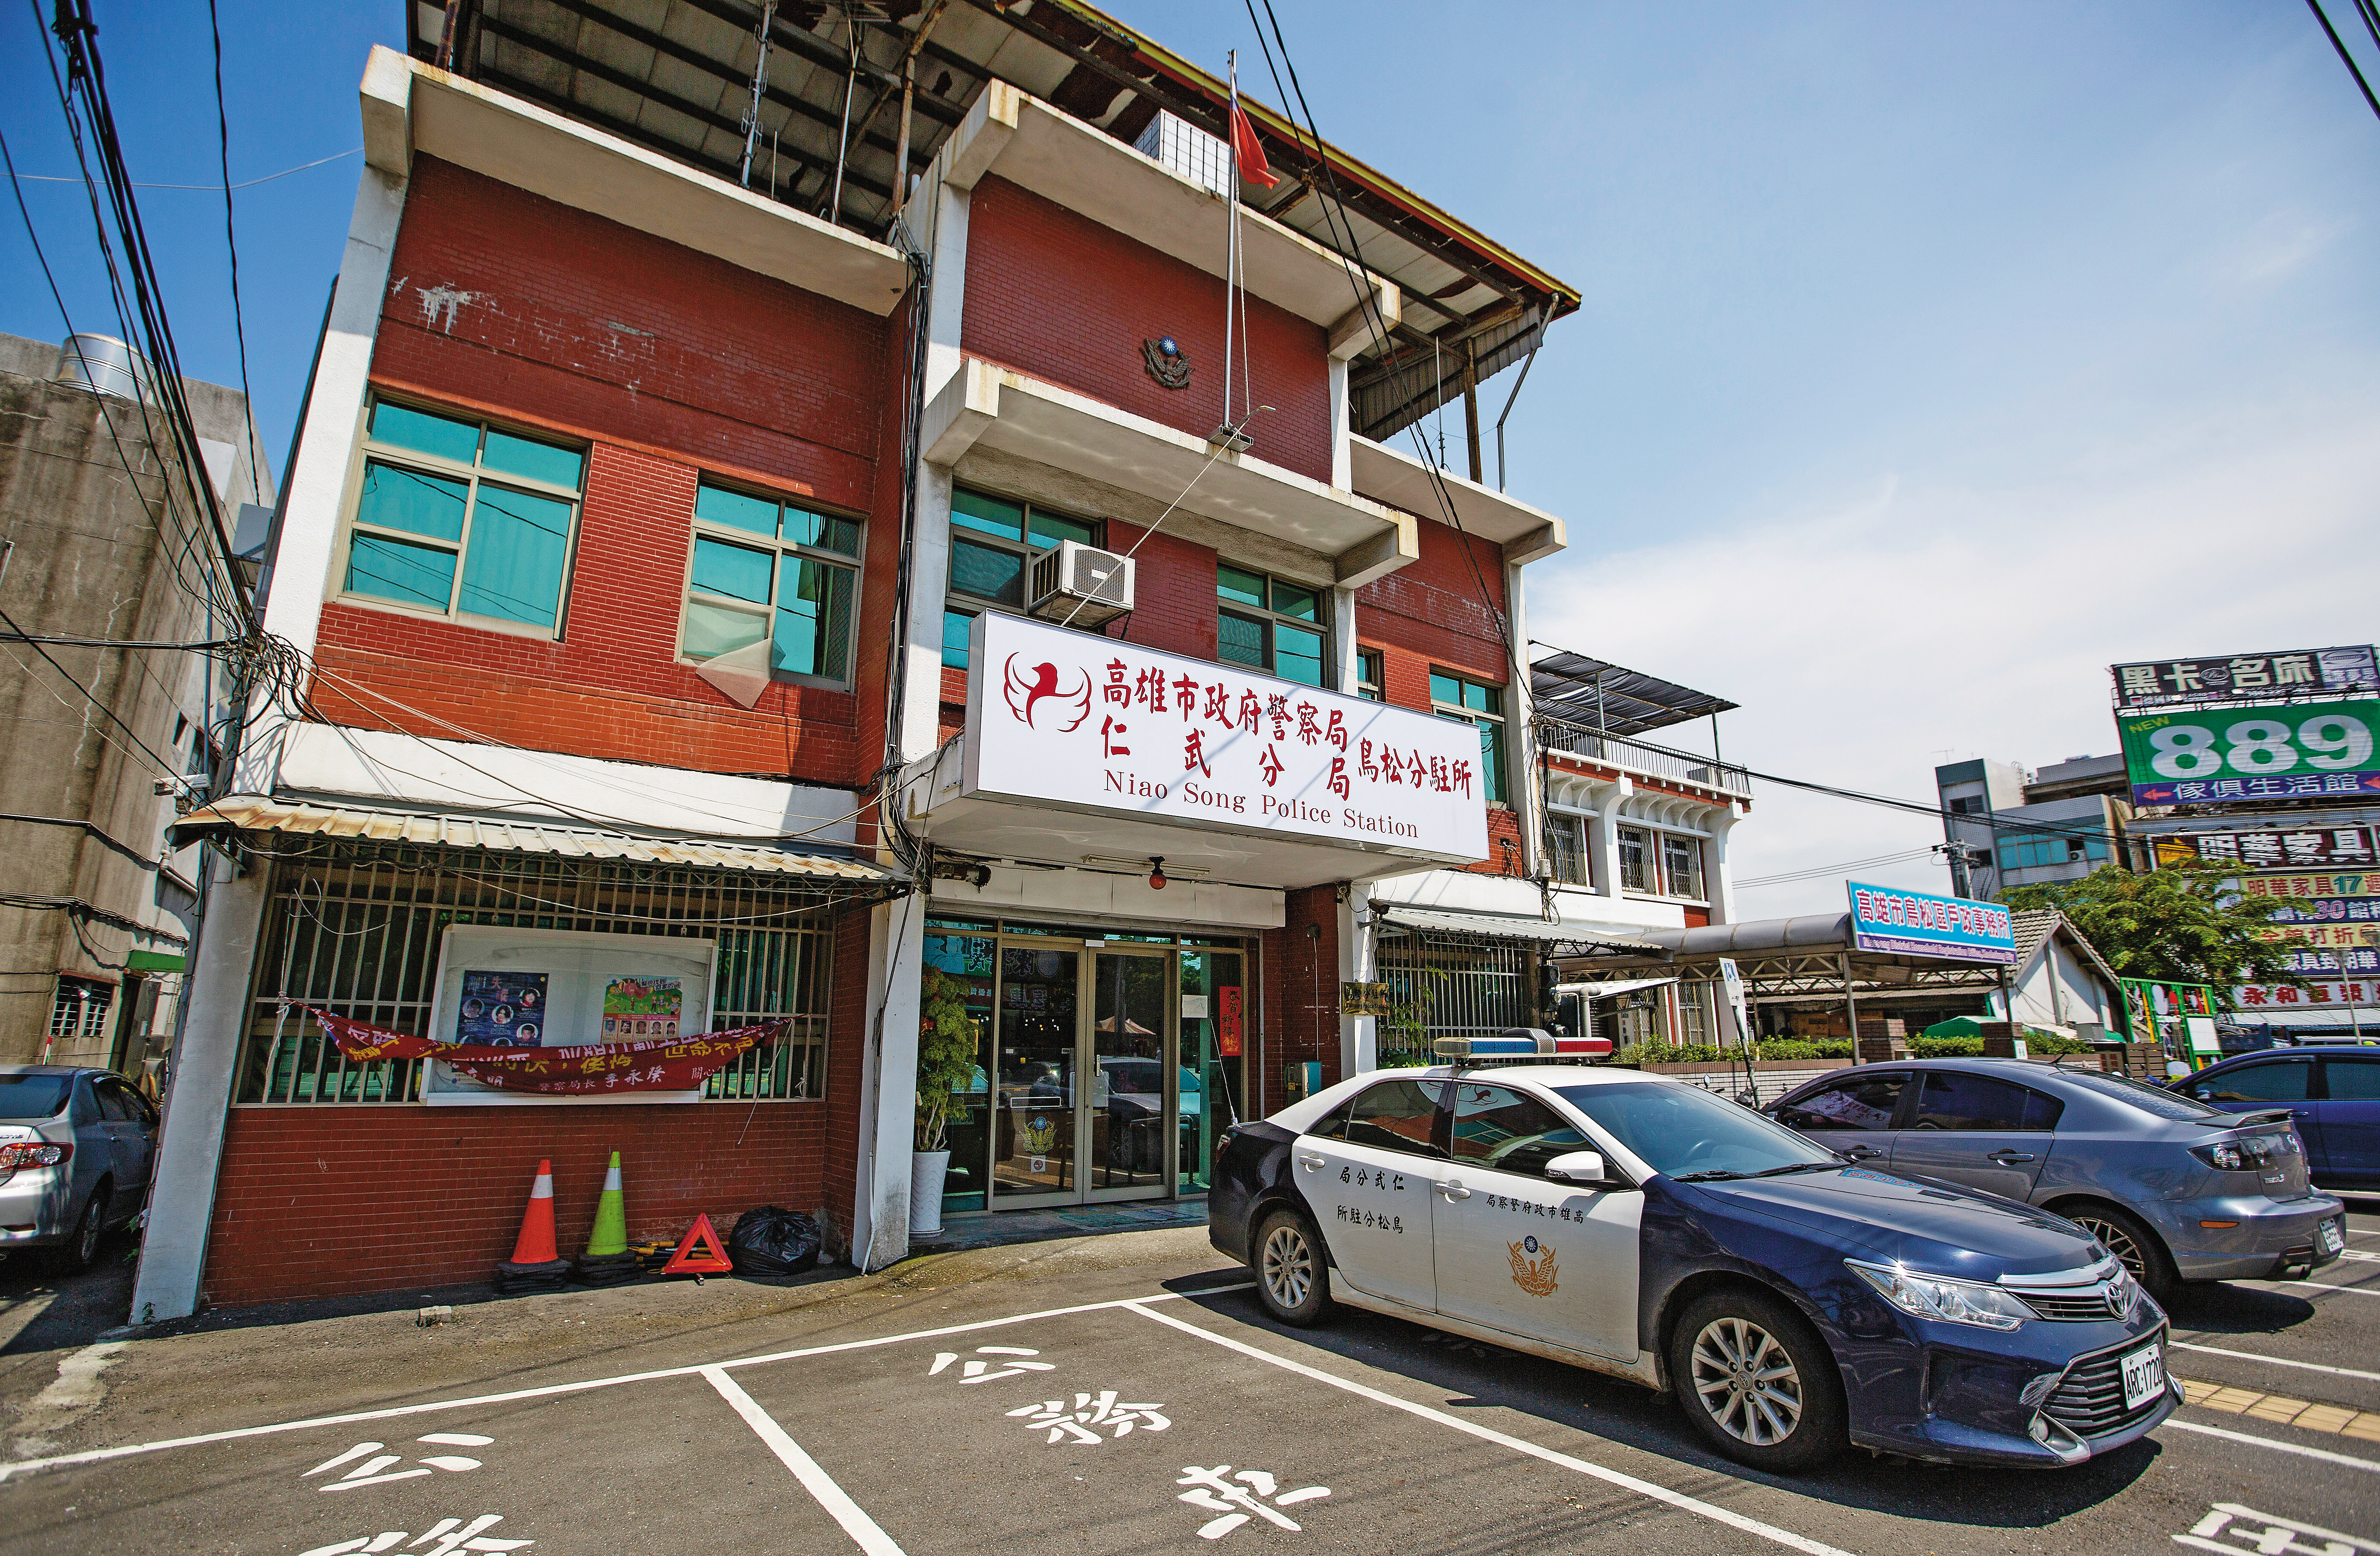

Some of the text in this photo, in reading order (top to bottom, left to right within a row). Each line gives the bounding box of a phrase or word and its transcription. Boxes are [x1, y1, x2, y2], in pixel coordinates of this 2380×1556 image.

[1104, 657, 1347, 753] 高雄市政府警察局
[2129, 715, 2170, 733] NEW
[1358, 737, 1472, 800] 鳥松分駐所
[2149, 715, 2374, 778] 889
[1104, 769, 1419, 838] Niao Song Police Station
[2172, 773, 2361, 800] 傢俱生活館
[1855, 889, 2011, 939] 高雄市鳥松區戶政事務所
[1890, 940, 1911, 950] District
